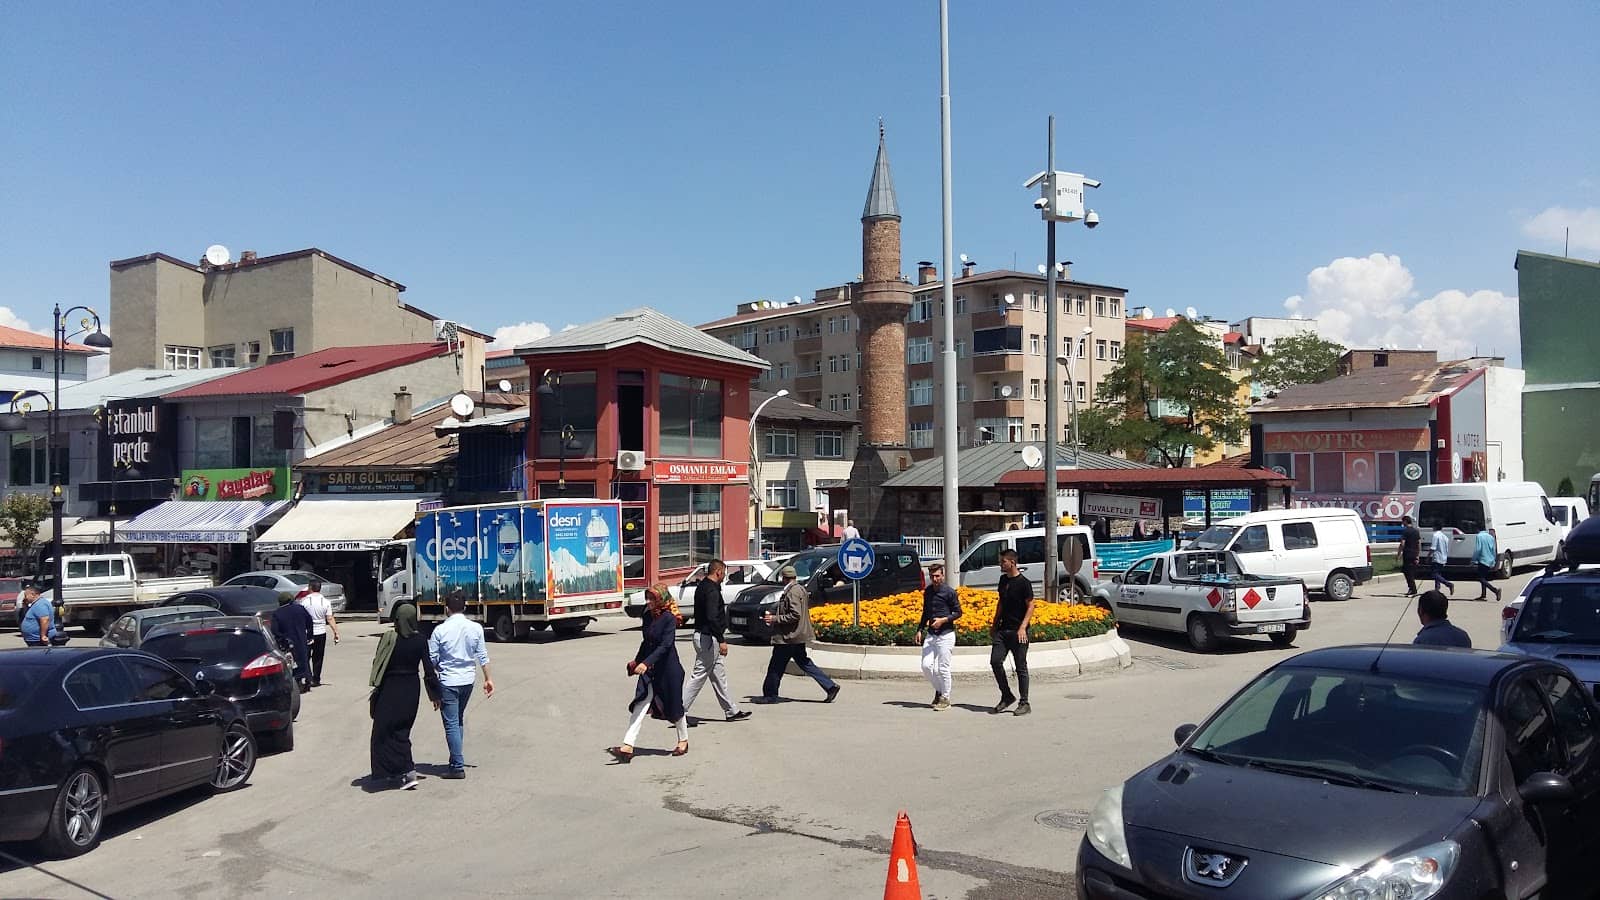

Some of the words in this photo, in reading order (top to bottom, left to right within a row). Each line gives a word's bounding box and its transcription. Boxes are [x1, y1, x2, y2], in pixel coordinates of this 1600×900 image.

[107, 405, 156, 435] istanbul
[1288, 431, 1366, 450] NOTER
[113, 436, 149, 466] perde
[328, 472, 355, 484] SARI
[669, 464, 708, 474] OSMANLI
[710, 465, 737, 474] EMLAK
[550, 511, 582, 527] desni
[426, 525, 488, 561] desni
